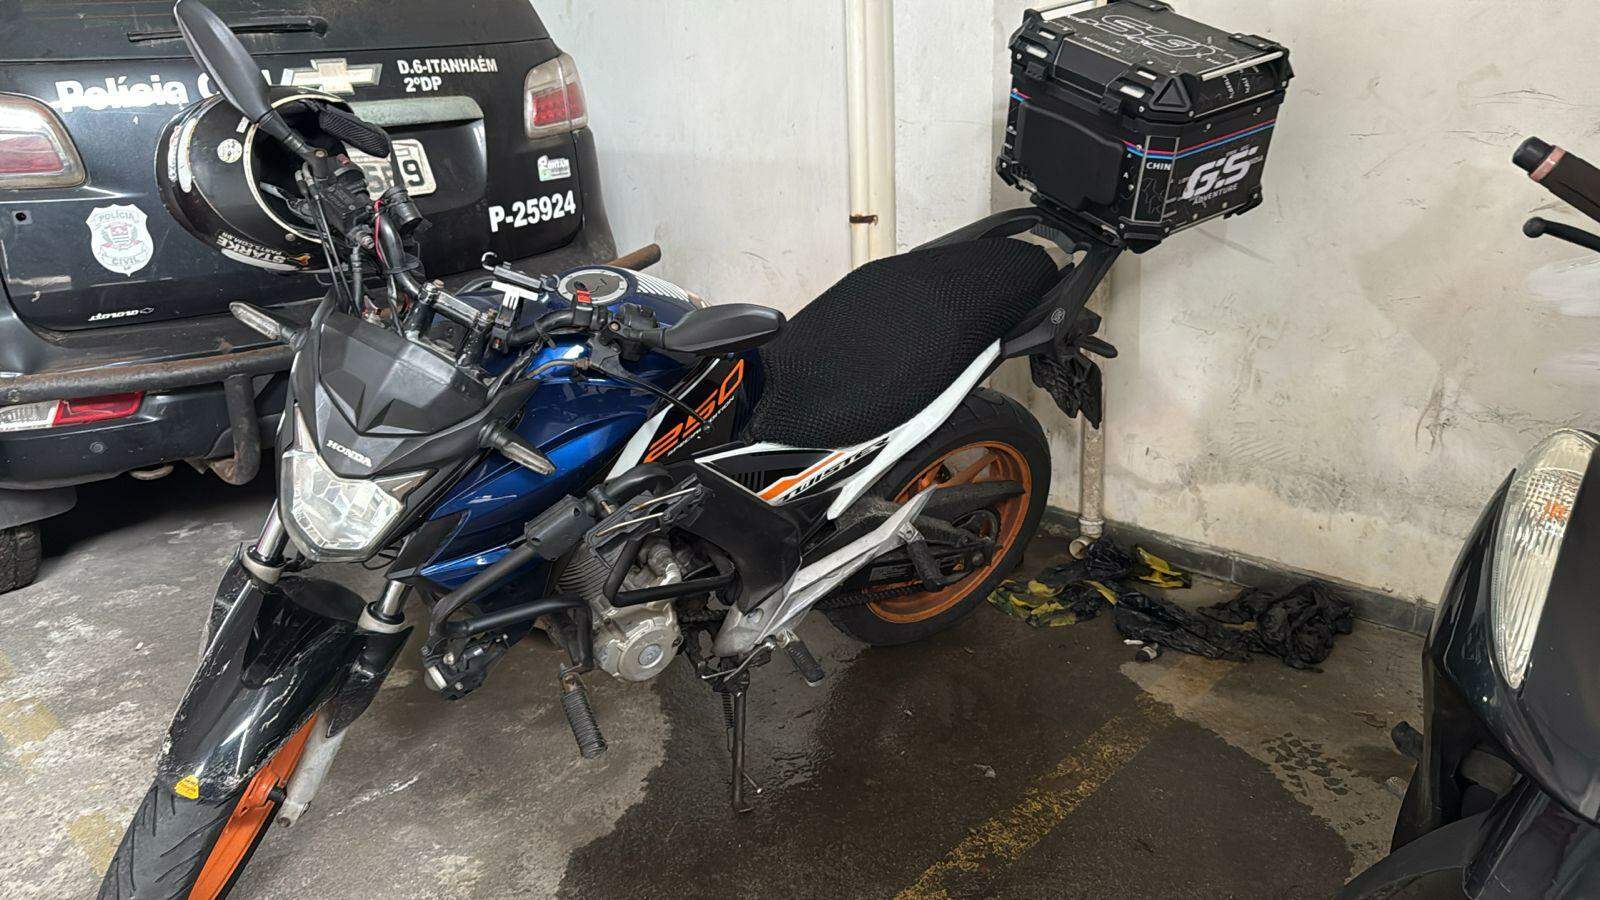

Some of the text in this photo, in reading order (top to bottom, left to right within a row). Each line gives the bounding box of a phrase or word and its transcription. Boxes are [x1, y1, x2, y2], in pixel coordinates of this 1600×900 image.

[397, 55, 499, 75] D.6-ITANHAÉM
[55, 74, 189, 113] Polícia
[1182, 146, 1260, 200] GS
[488, 190, 577, 233] P-25924
[216, 235, 288, 264] STARKE
[325, 439, 373, 468] HONDA
